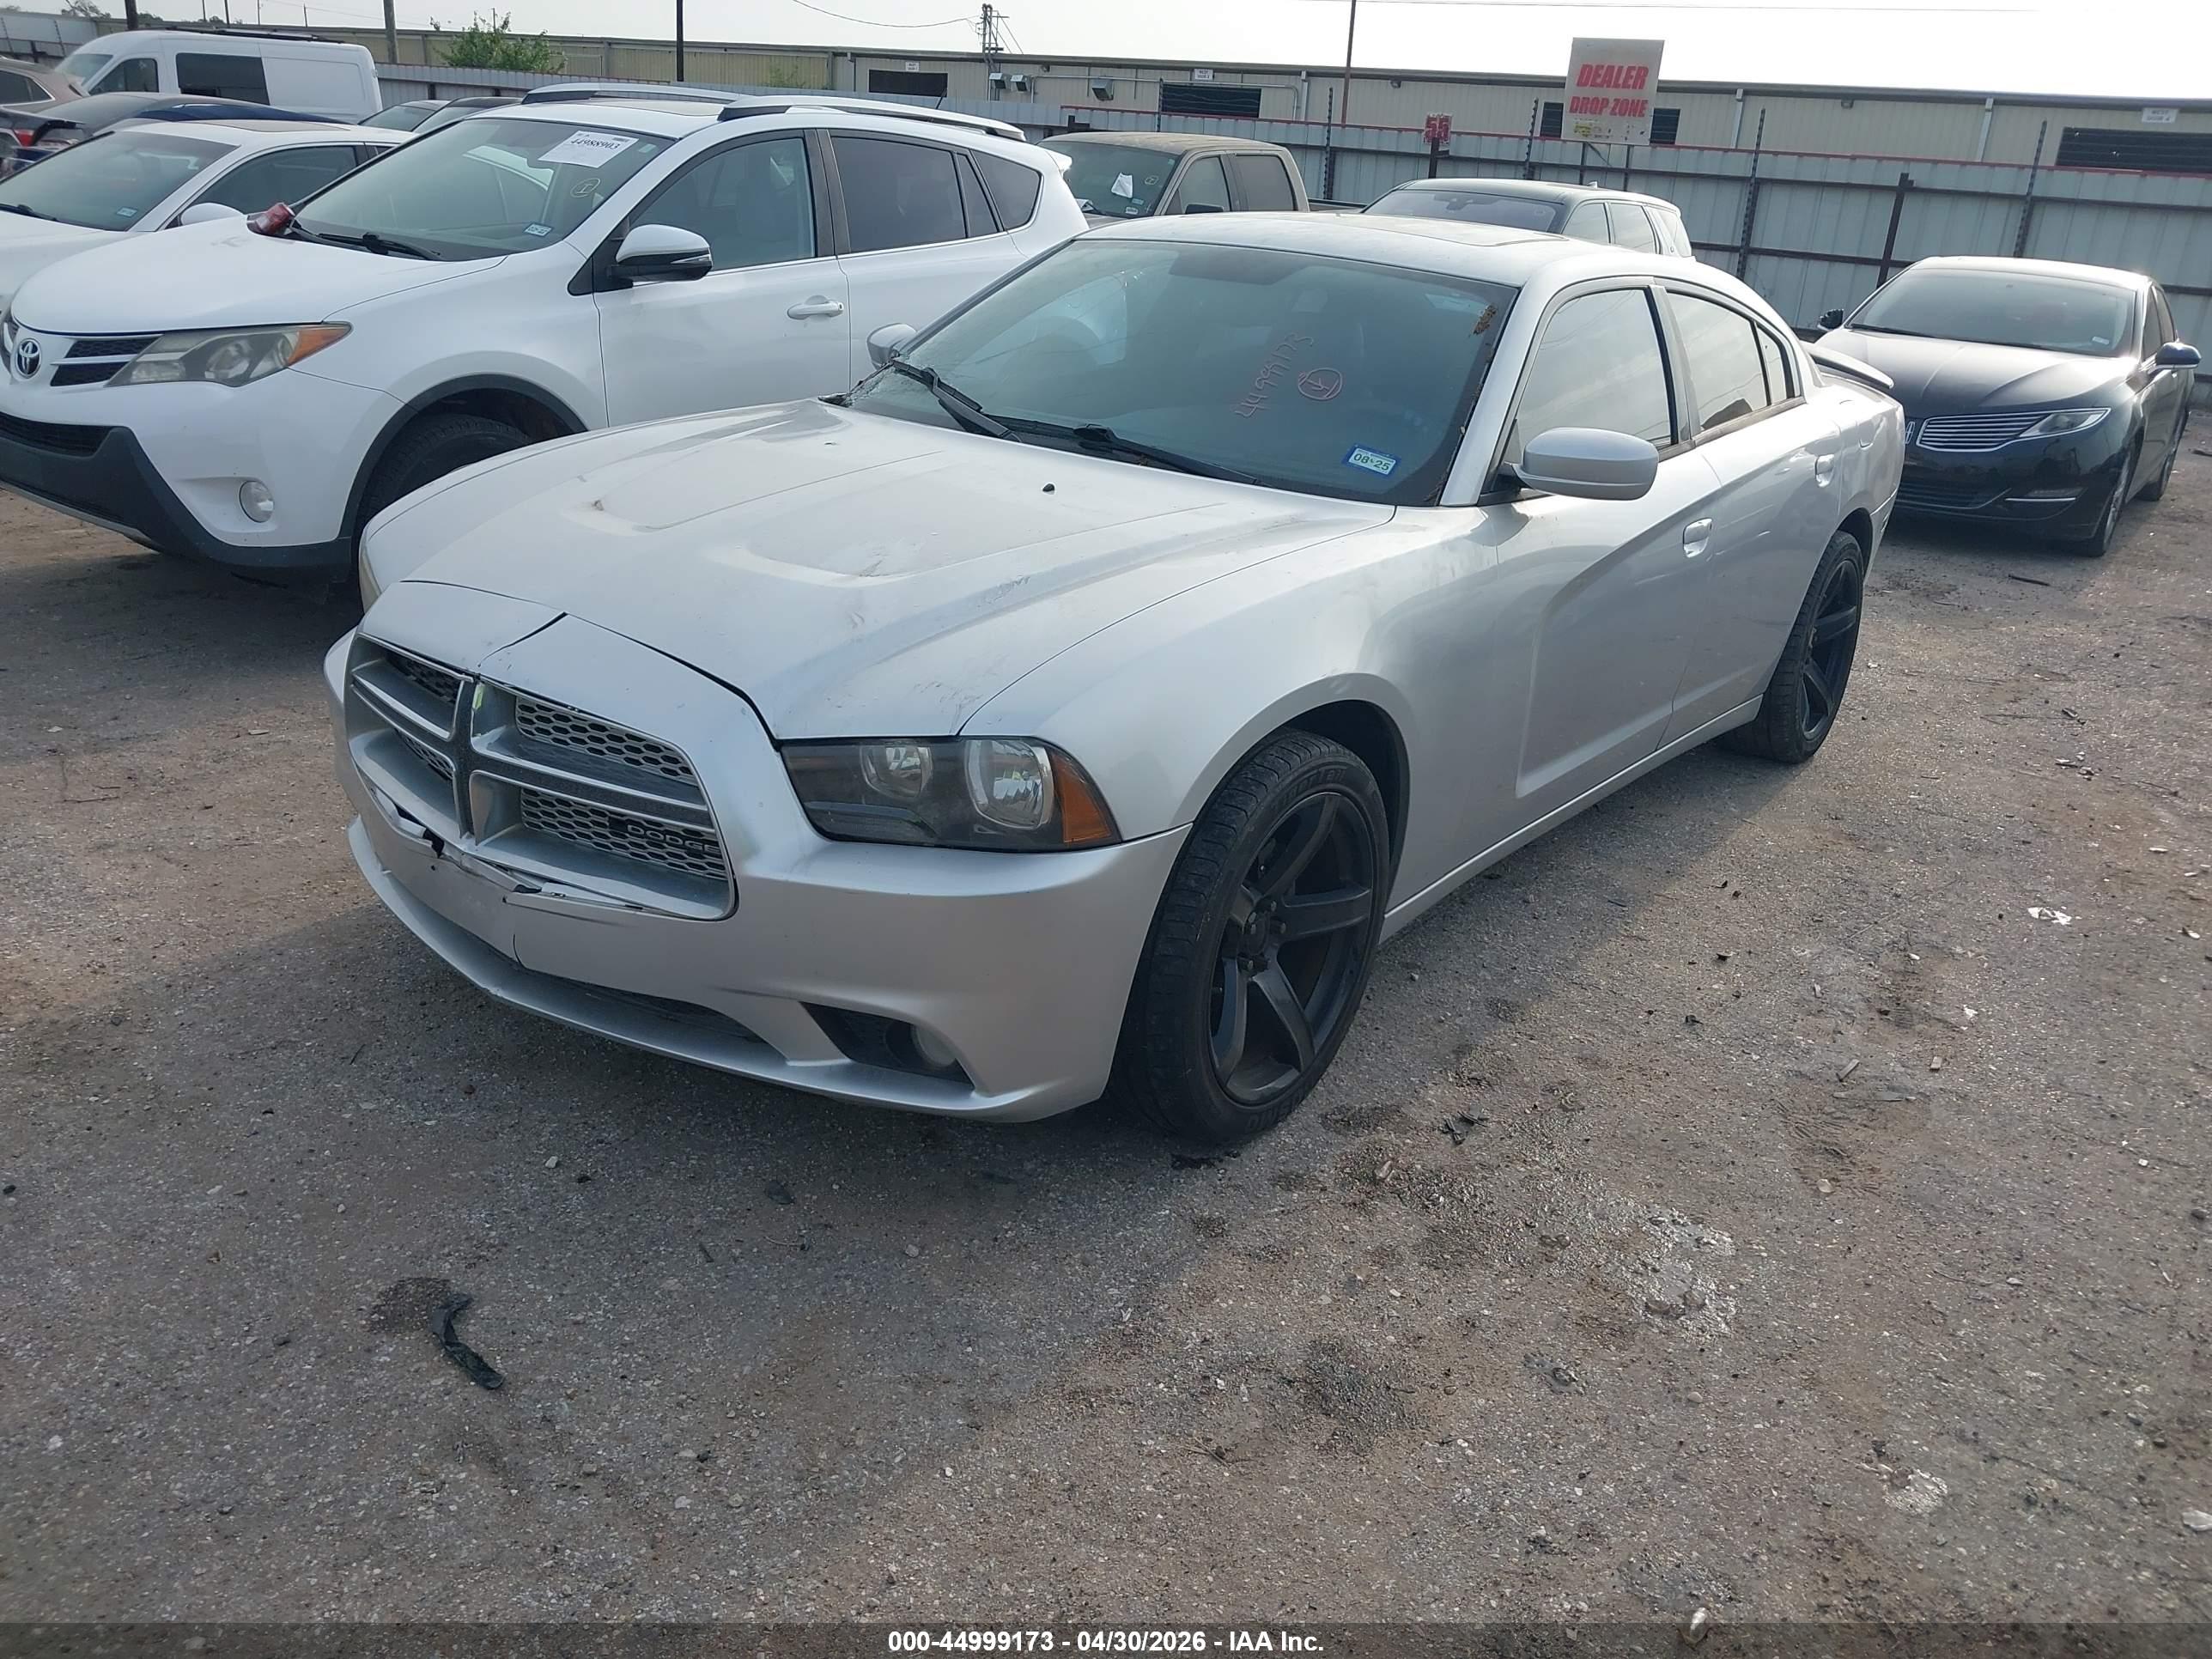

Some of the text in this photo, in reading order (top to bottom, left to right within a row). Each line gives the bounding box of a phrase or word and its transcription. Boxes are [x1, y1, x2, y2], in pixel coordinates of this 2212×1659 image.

[1577, 64, 1649, 90] DEALER
[1569, 95, 1649, 118] DROP ZONE
[570, 138, 621, 150] 44988903
[1373, 459, 1391, 471] 25
[627, 824, 721, 855] DODGE
